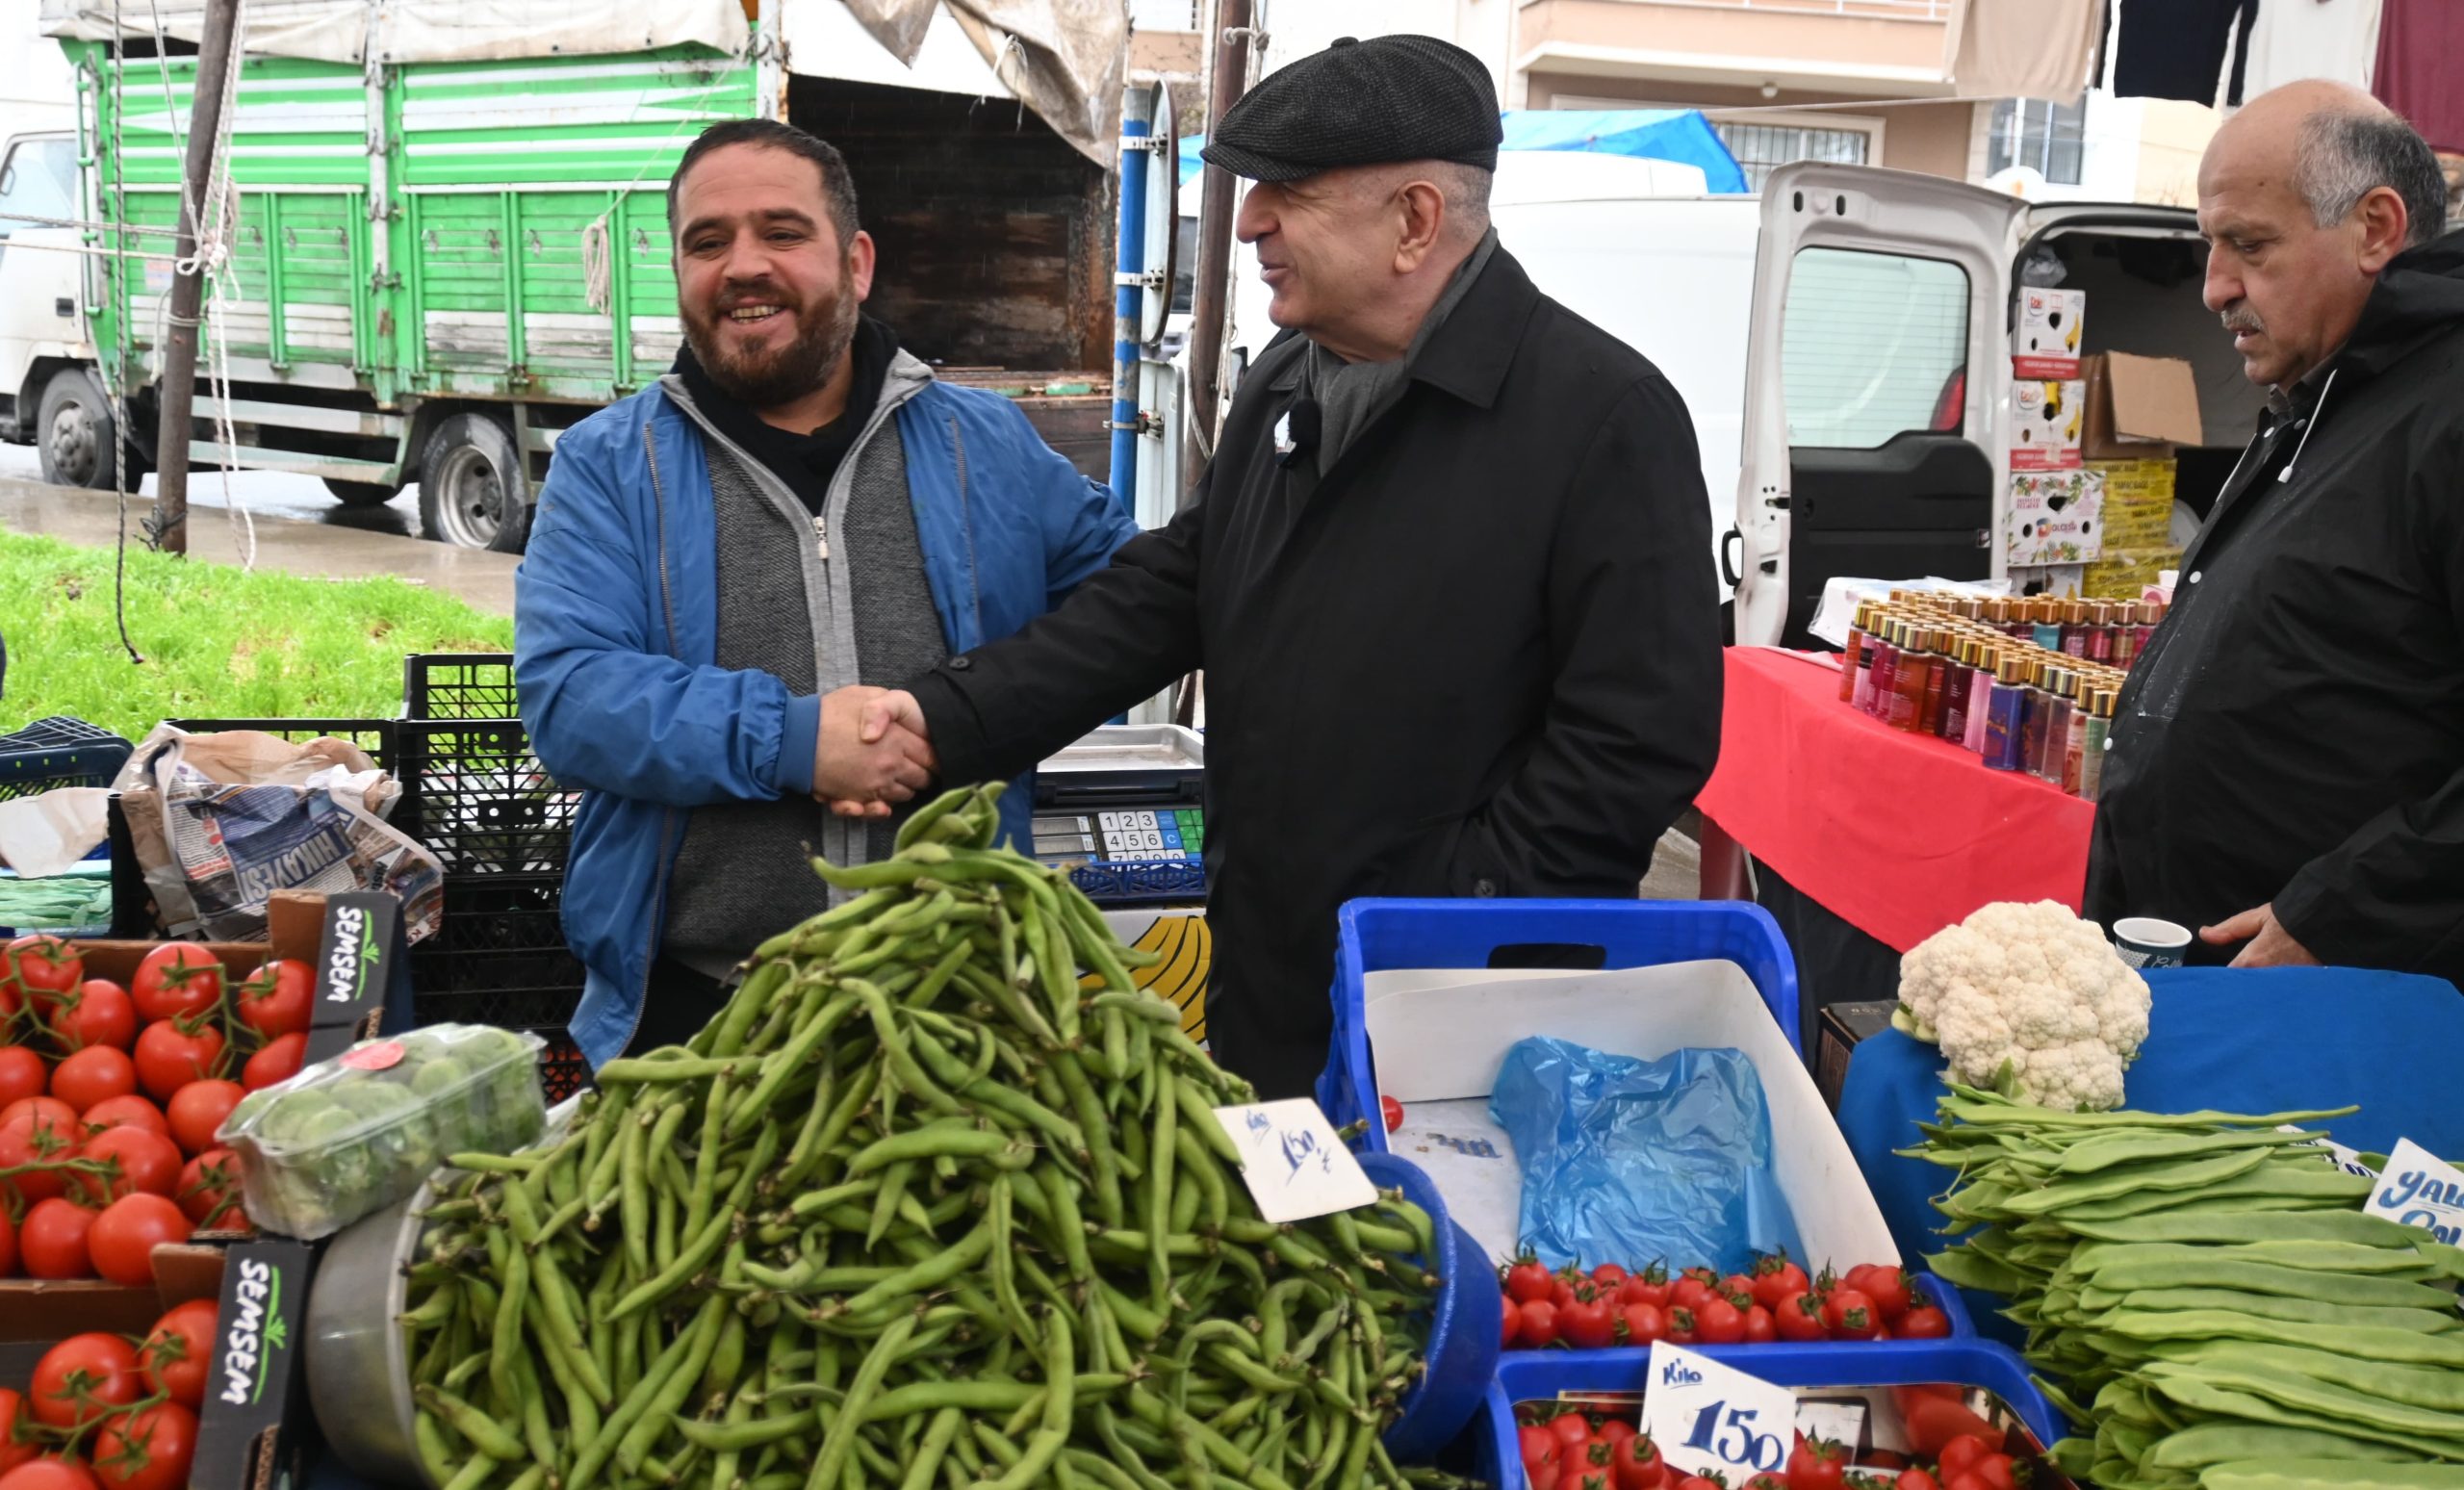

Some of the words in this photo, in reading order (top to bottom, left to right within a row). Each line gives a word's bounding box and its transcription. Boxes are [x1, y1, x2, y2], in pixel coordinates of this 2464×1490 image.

[1105, 816, 1113, 827] 1
[1123, 815, 1135, 827] 2
[1143, 814, 1153, 827] 3
[1110, 835, 1119, 846] 4
[1129, 835, 1139, 846] 5
[1148, 835, 1158, 845] 6
[1167, 835, 1176, 844] C
[326, 905, 364, 1003] SEMSEM
[220, 1258, 270, 1405] SEMSEM
[1662, 1356, 1704, 1387] Kilo
[1681, 1399, 1785, 1474] 150
